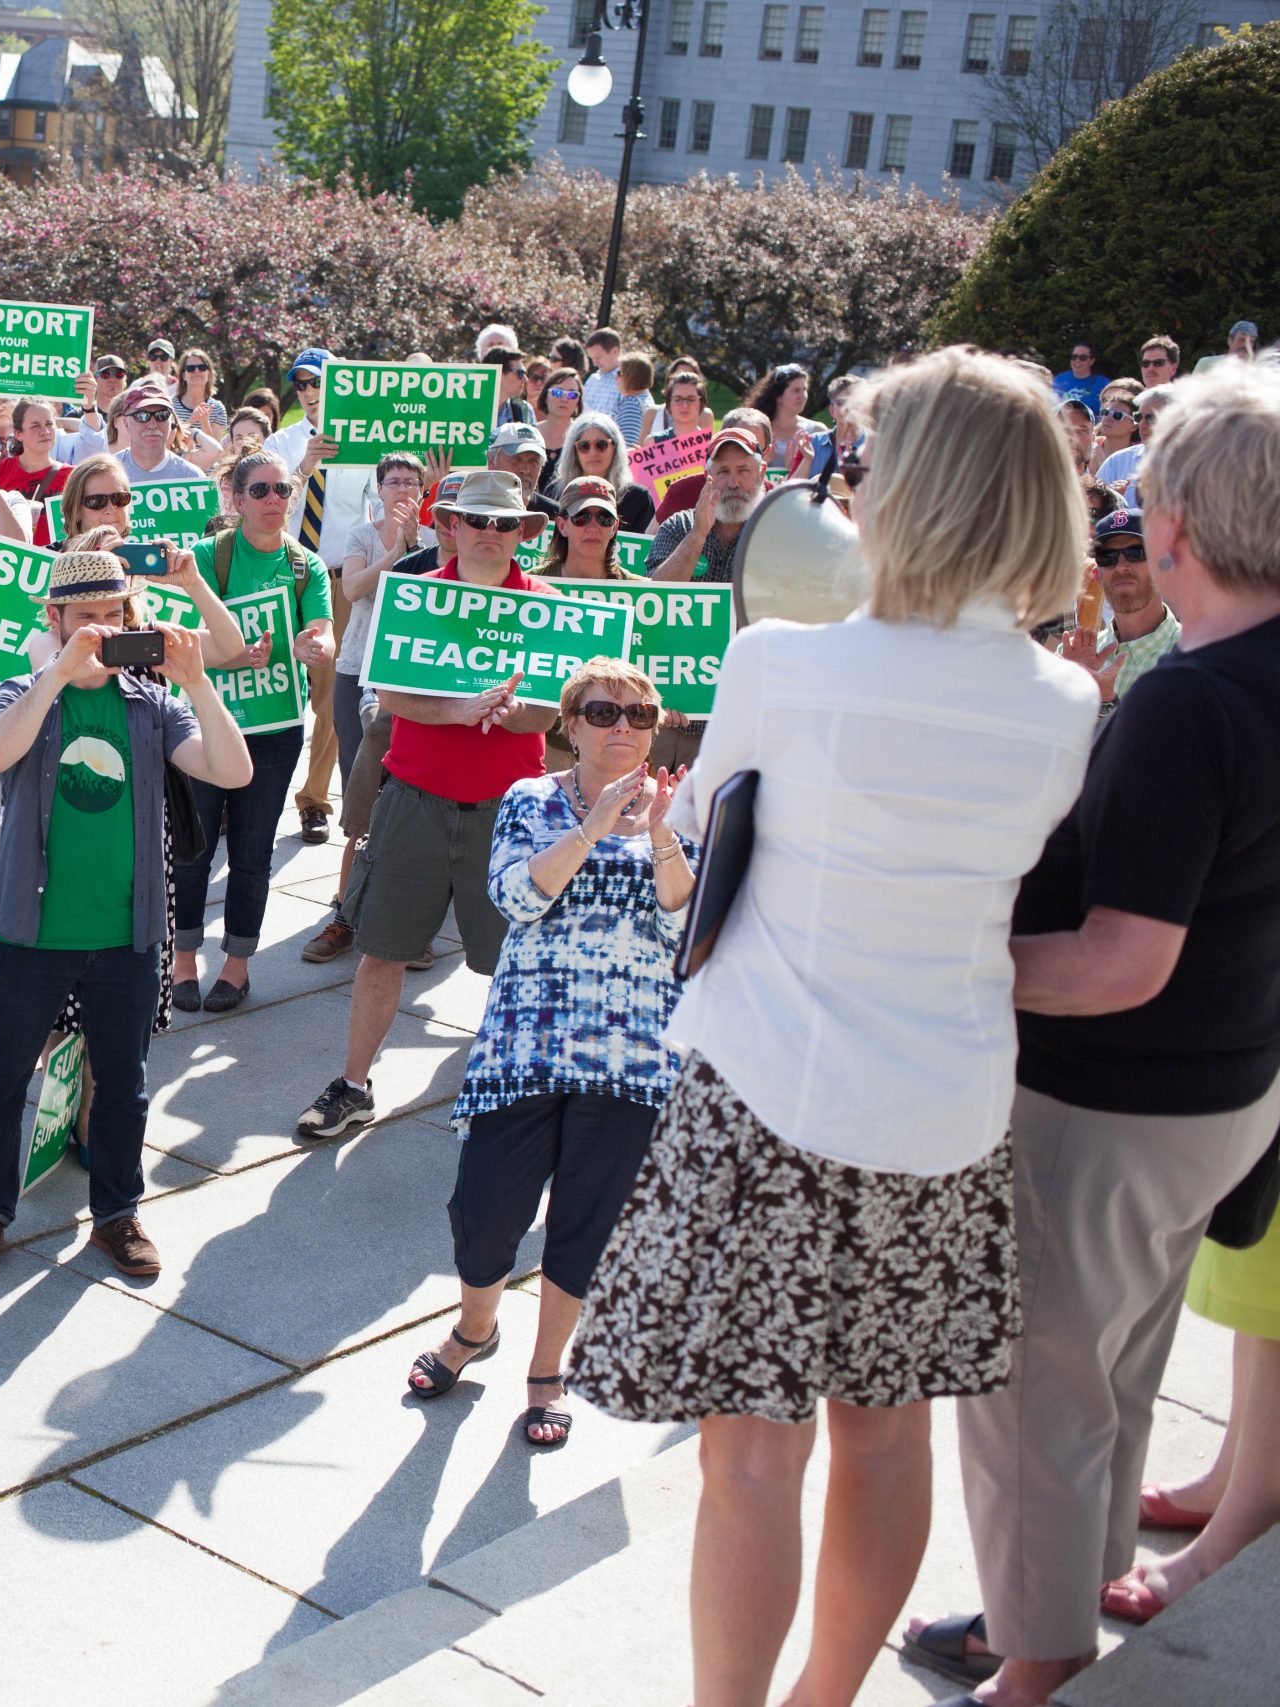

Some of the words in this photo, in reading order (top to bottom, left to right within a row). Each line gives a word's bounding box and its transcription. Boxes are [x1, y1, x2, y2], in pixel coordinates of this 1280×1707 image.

[333, 368, 489, 400] SUPPORT
[392, 402, 427, 414] YOUR
[330, 418, 486, 446] TEACHERS
[672, 432, 712, 452] THROW
[129, 485, 210, 514] PORT
[130, 518, 156, 529] OUR
[393, 583, 616, 637] SUPPORT
[475, 627, 524, 645] YOUR
[384, 633, 584, 680] TEACHER
[216, 662, 290, 702] HERS
